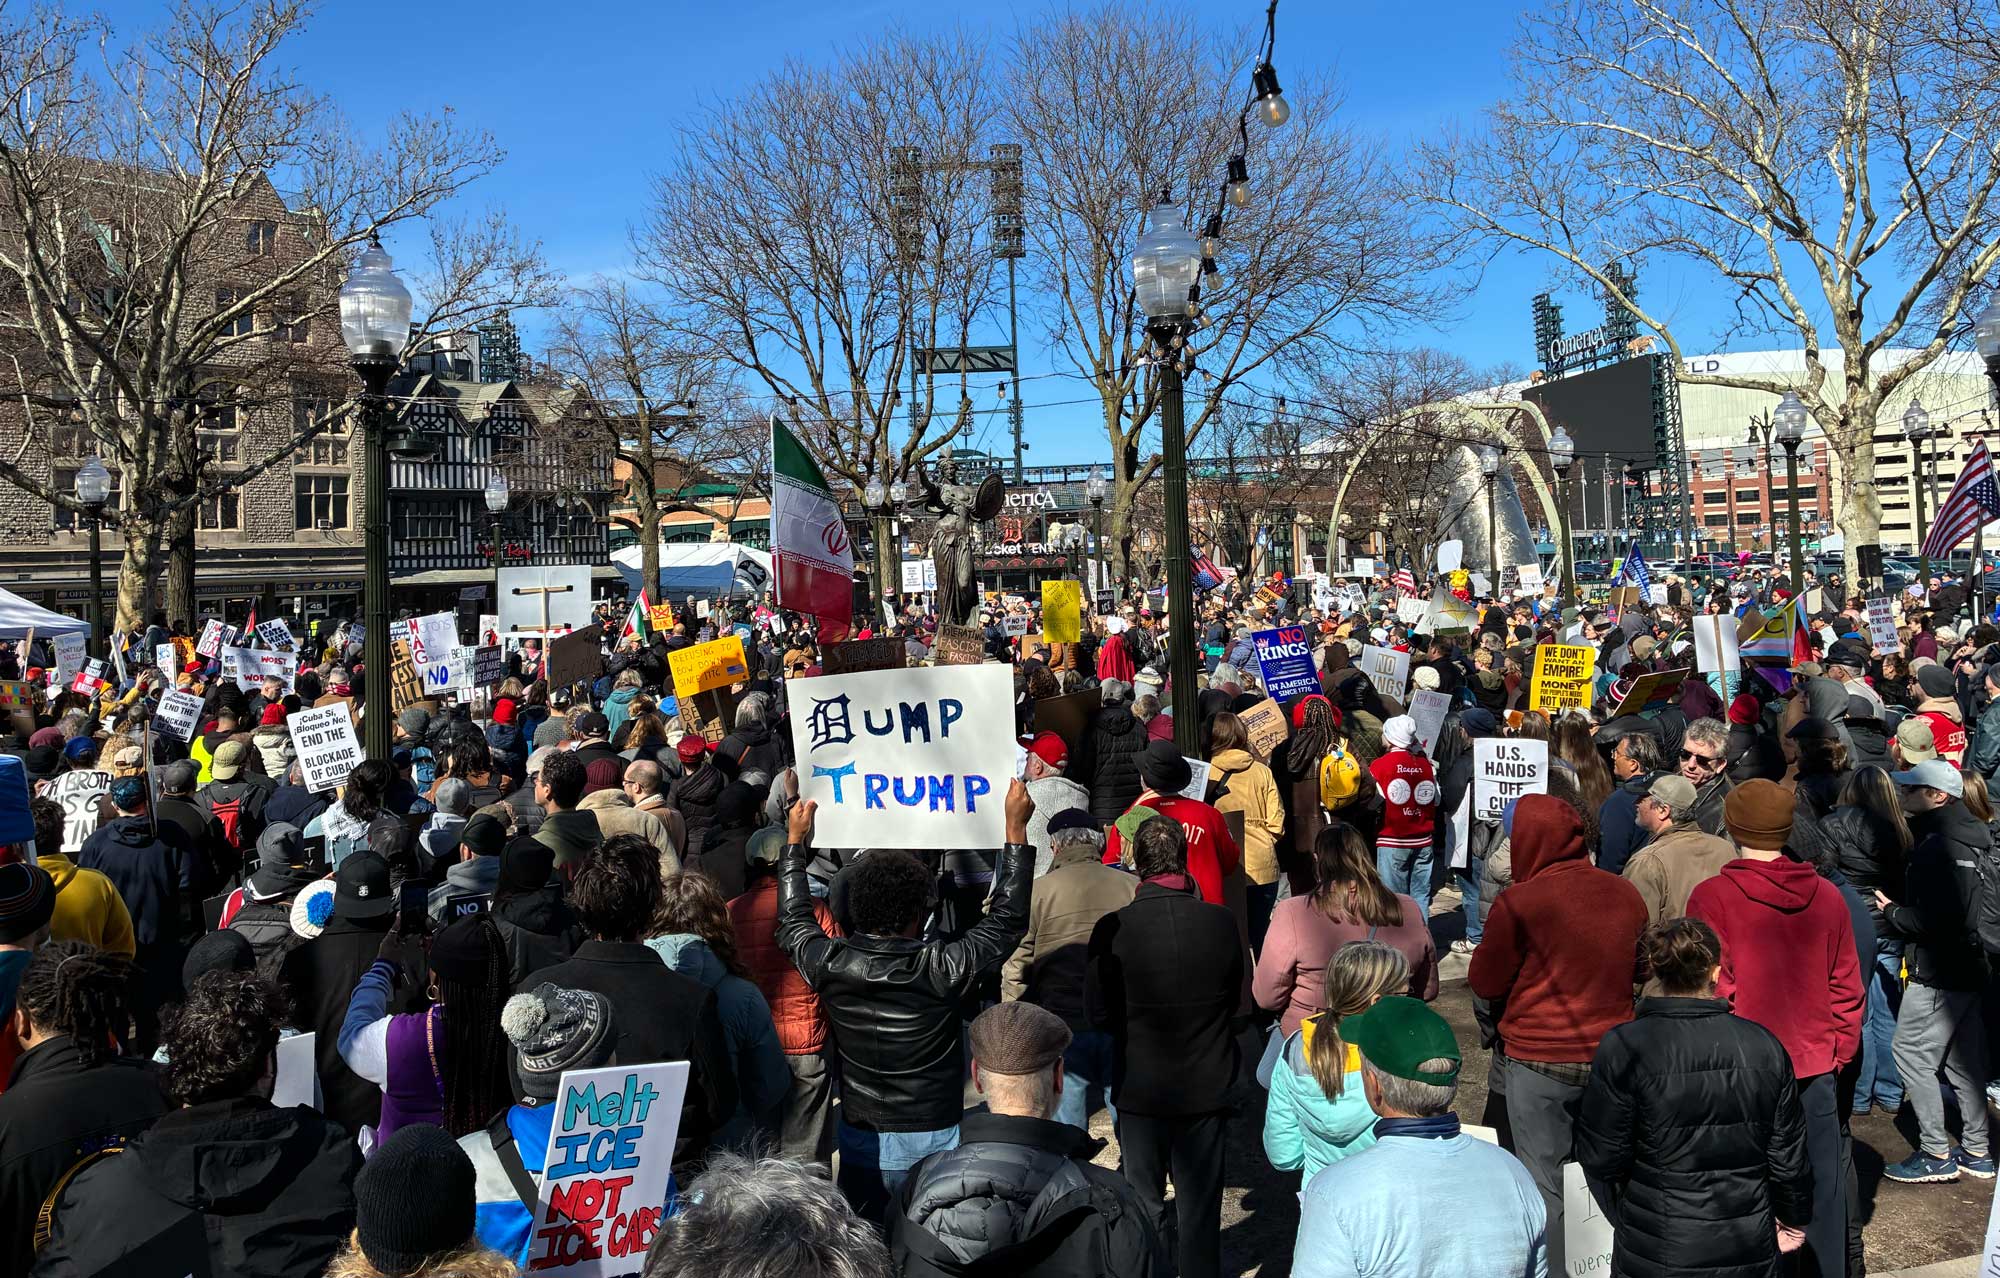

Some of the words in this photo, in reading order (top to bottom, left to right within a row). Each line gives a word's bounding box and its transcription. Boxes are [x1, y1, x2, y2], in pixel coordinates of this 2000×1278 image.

[1691, 360, 1719, 373] LD
[258, 621, 273, 632] MY
[263, 627, 285, 638] CATS
[267, 632, 290, 644] HATE
[1278, 628, 1304, 644] NO
[939, 637, 983, 652] FASCISM
[1258, 642, 1308, 661] KINGS
[488, 650, 501, 660] WILL
[673, 646, 714, 663] REFUSING
[721, 643, 732, 651] TO
[937, 650, 948, 659] IS
[949, 651, 983, 663] FASCISM
[1545, 647, 1557, 657] WE
[1560, 648, 1586, 660] DON'T
[486, 661, 501, 670] MAKE
[676, 664, 693, 675] BOW
[698, 656, 724, 668] DOWN
[1376, 653, 1396, 676] NO
[1543, 664, 1584, 678] EMPIRE!
[243, 674, 265, 682] WOR
[428, 664, 449, 685] NO
[483, 671, 500, 681] GREAT
[678, 675, 701, 688] SINCE
[1269, 683, 1279, 691] IN
[1280, 677, 1318, 690] AMERICA
[1371, 674, 1404, 697] INGS
[1541, 681, 1583, 690] MONEY
[1278, 688, 1298, 697] SINCE
[1298, 686, 1312, 694] 1776
[1540, 695, 1557, 706] NOT
[1559, 697, 1583, 707] WAR!
[164, 703, 180, 713] END
[180, 707, 195, 717] THE
[158, 715, 191, 729] BLOCKADE
[294, 720, 330, 735] ¡Bloqueo
[332, 715, 346, 725] No!
[299, 713, 323, 725] ¡Cuba
[805, 693, 963, 753] DUMP
[157, 722, 166, 730] OF
[166, 724, 187, 735] CUBA!
[301, 733, 323, 748] END
[324, 728, 346, 743] THE
[305, 747, 355, 768] BLOCKADE
[1496, 745, 1525, 761] U.S.
[311, 768, 323, 780] OF
[325, 761, 355, 777] CUBA!
[1485, 761, 1537, 778] HANDS
[66, 771, 114, 792] BROTH
[811, 760, 991, 813] TRUMP
[1499, 782, 1523, 795] OFF
[1489, 796, 1508, 810] CU
[1182, 822, 1204, 844] OIT
[456, 903, 479, 916] NO
[562, 1074, 659, 1132] Melt
[547, 1125, 643, 1180] ICE
[545, 1176, 634, 1224] NOT
[529, 1219, 604, 1271] ICE
[1573, 1253, 1612, 1277] were
